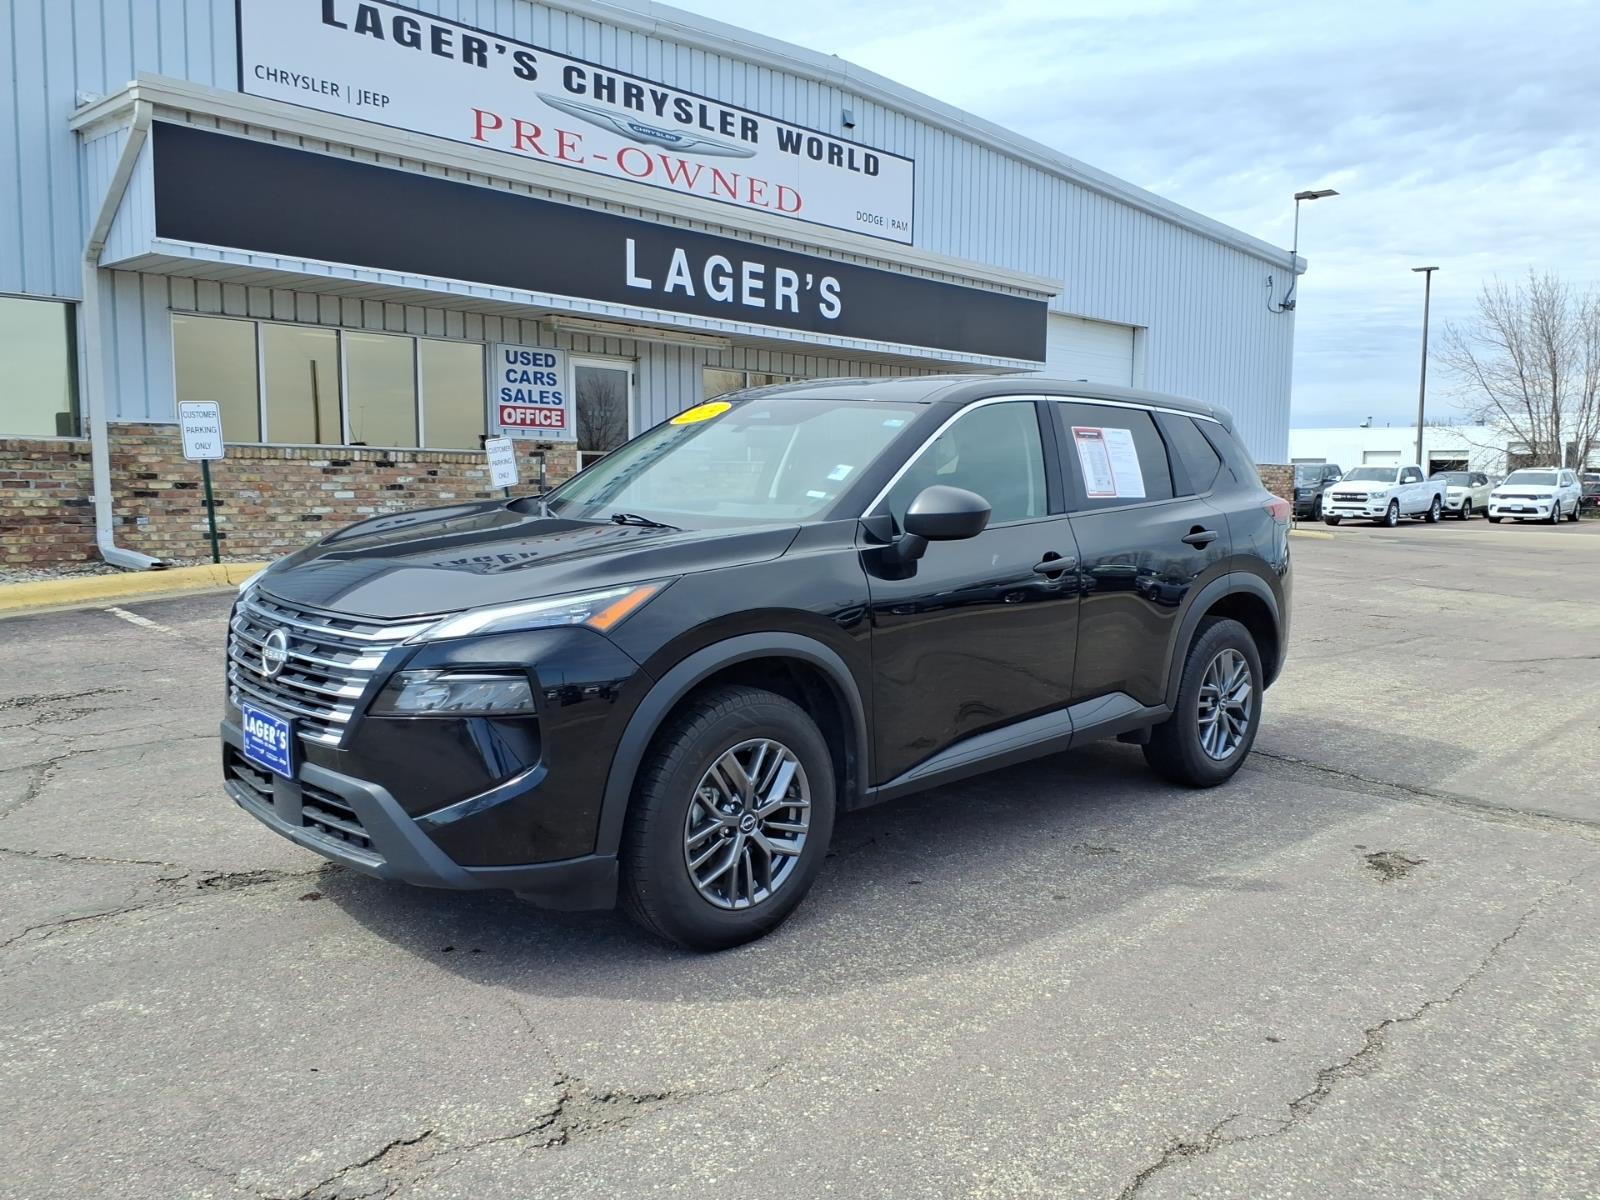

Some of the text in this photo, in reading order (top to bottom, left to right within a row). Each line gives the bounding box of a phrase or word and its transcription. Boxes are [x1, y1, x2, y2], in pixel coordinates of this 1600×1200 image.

[254, 65, 390, 108] CHRYSLER JEEP
[322, 0, 880, 177] LAGER'S CHRYSLER WORLD
[633, 125, 676, 141] CHRYSLER
[471, 107, 802, 213] PRE-OWNED
[856, 210, 908, 232] DODGE RAM
[625, 238, 842, 319] LAGER'S
[505, 349, 556, 368] USED
[505, 368, 558, 387] CARS
[501, 387, 563, 405] SALES
[182, 410, 217, 419] CUSTOMER
[503, 407, 562, 426] OFFICE
[185, 426, 217, 434] PARKING
[194, 442, 211, 450] ONLY
[244, 713, 286, 750] LAGER'S
